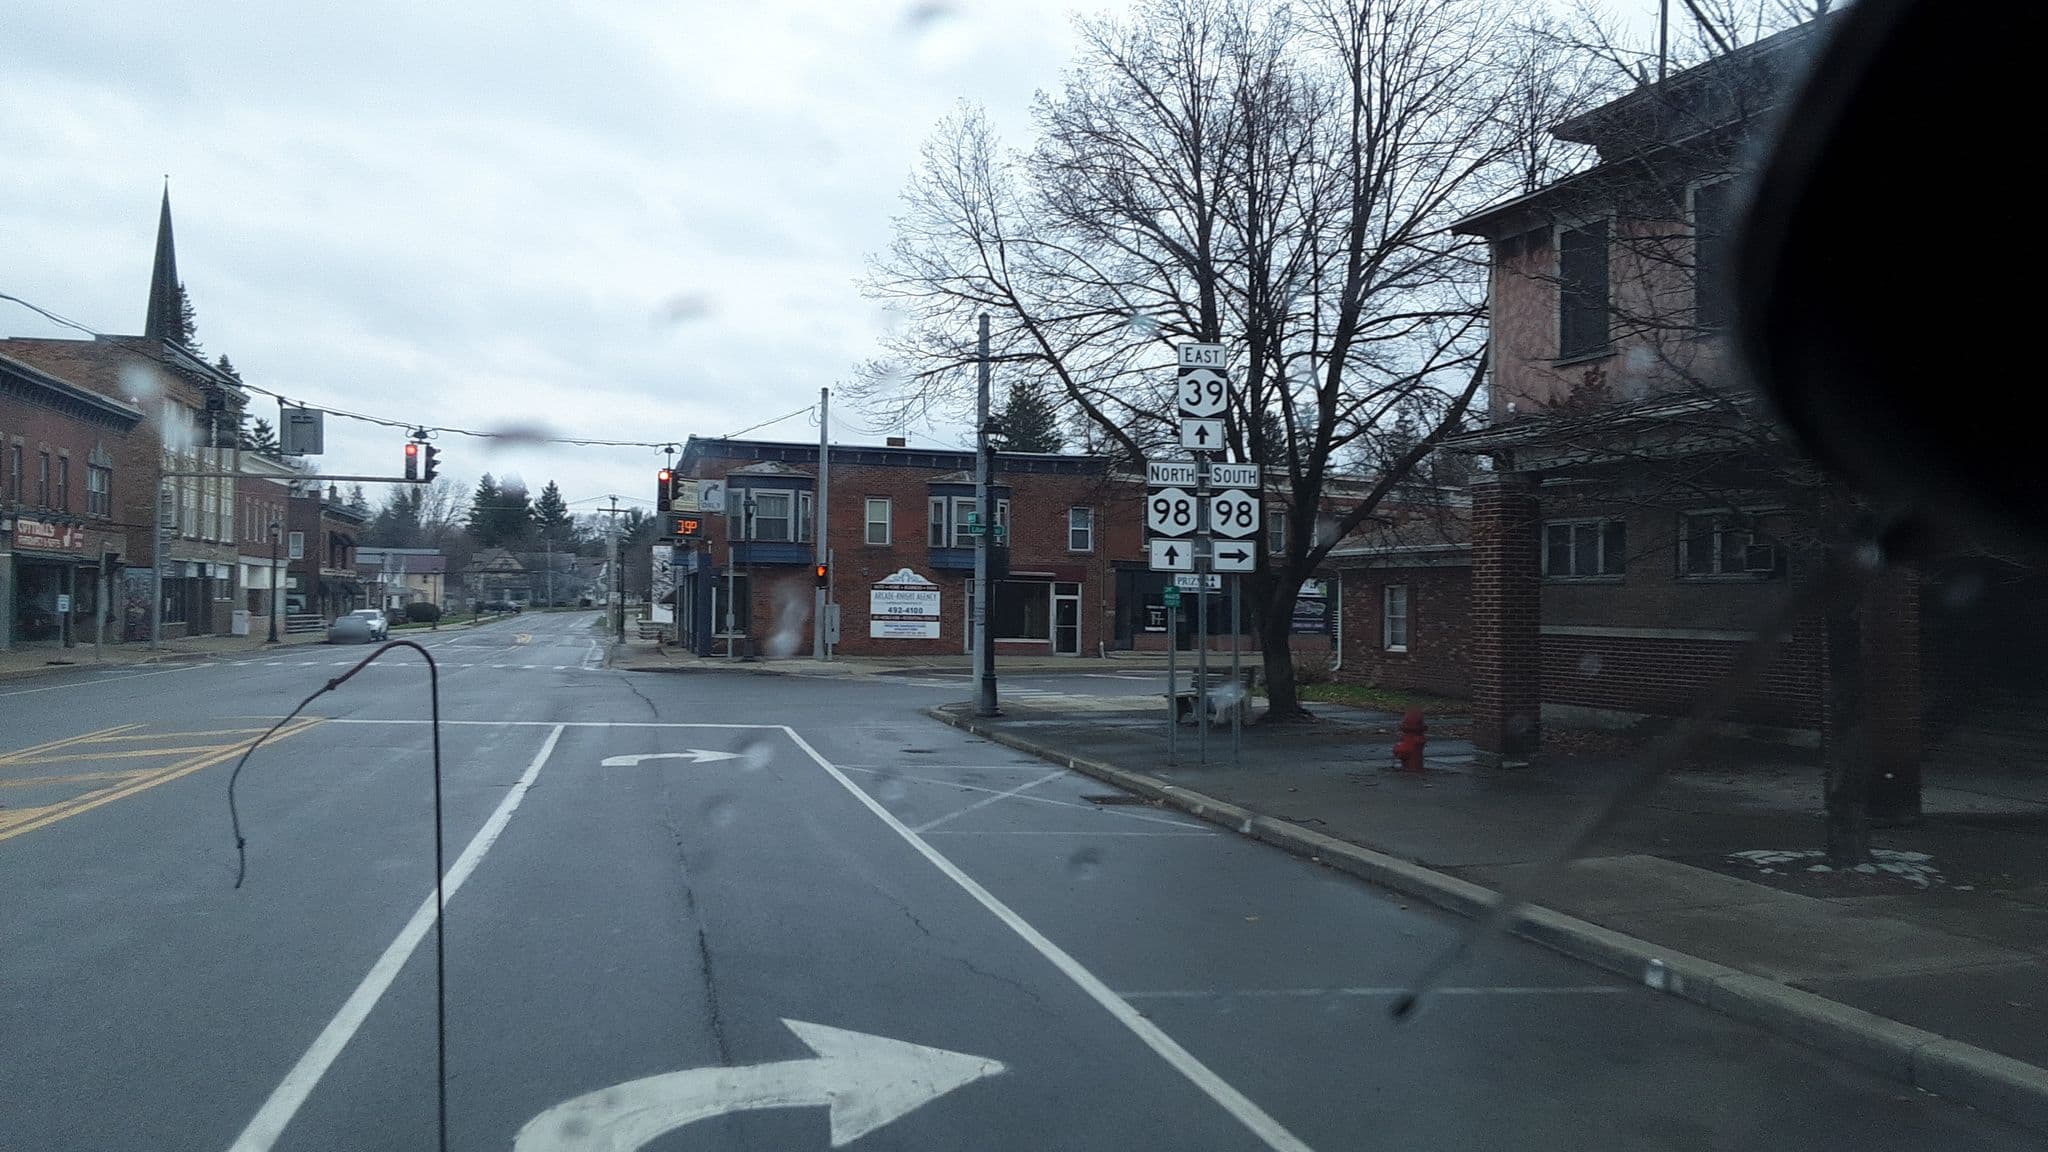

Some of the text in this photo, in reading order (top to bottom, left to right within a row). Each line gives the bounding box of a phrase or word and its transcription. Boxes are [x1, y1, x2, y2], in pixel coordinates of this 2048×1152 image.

[1185, 347, 1220, 364] EAST
[1185, 379, 1223, 407] 39
[1150, 465, 1195, 483] NORTH
[1213, 467, 1257, 484] SOUTH
[1153, 498, 1191, 527] 98
[1215, 499, 1253, 528] 98
[887, 606, 924, 614] 492-4100
